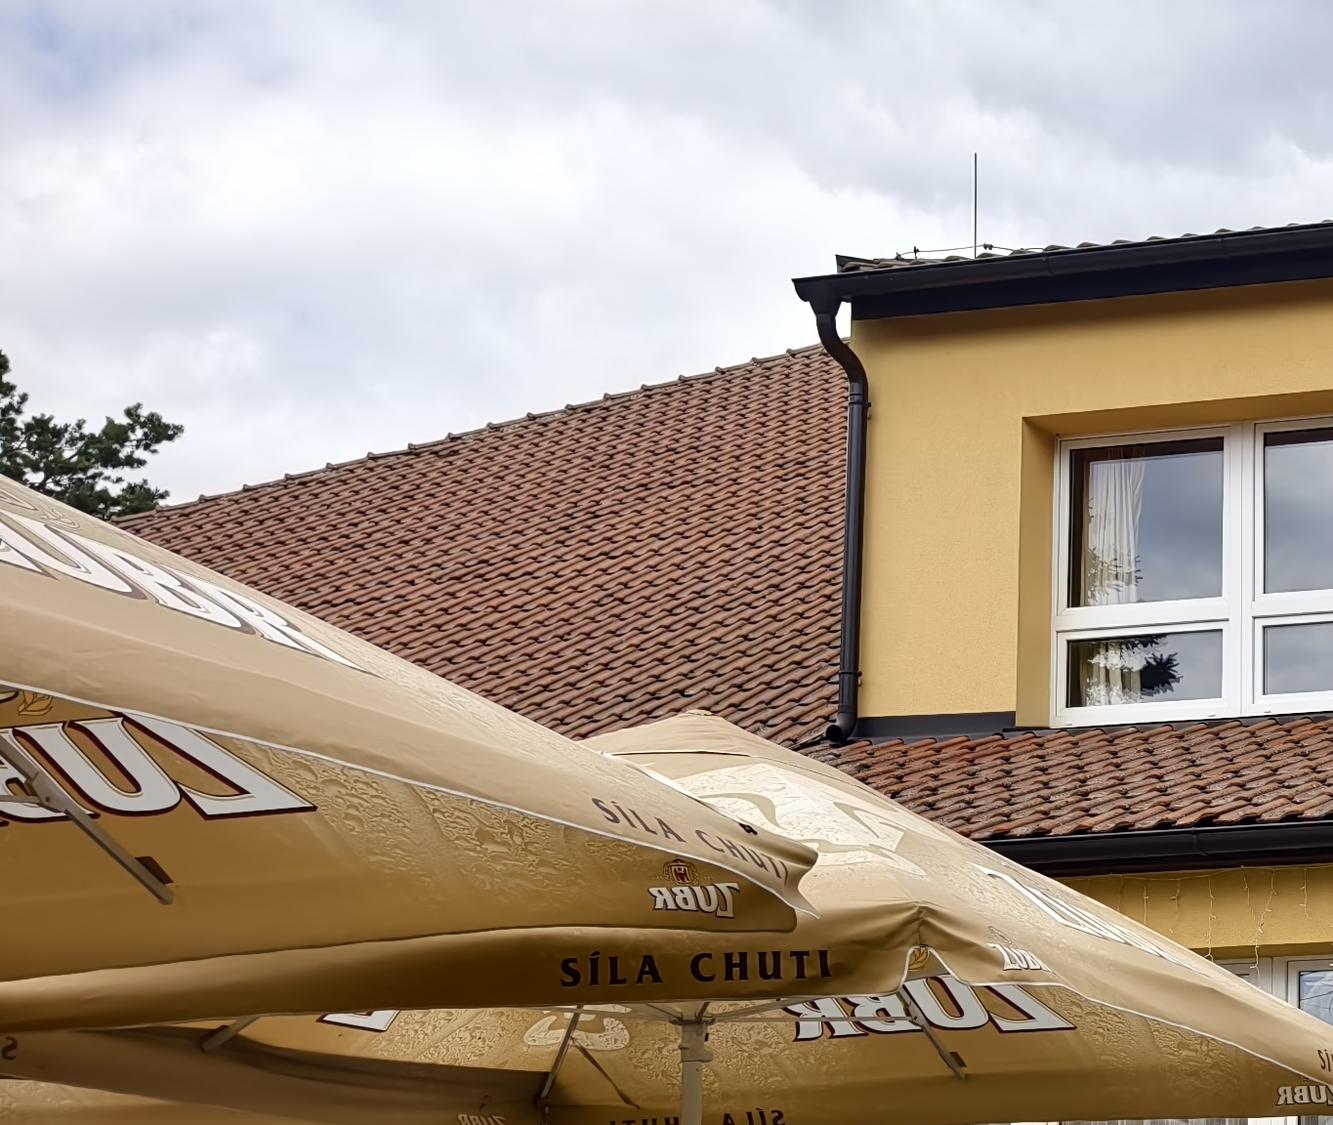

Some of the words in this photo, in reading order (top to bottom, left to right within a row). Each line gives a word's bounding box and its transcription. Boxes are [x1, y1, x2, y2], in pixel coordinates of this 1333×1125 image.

[591, 797, 687, 843] SÍLA
[560, 949, 663, 987] SÍLA
[690, 950, 832, 983] CHUTI
